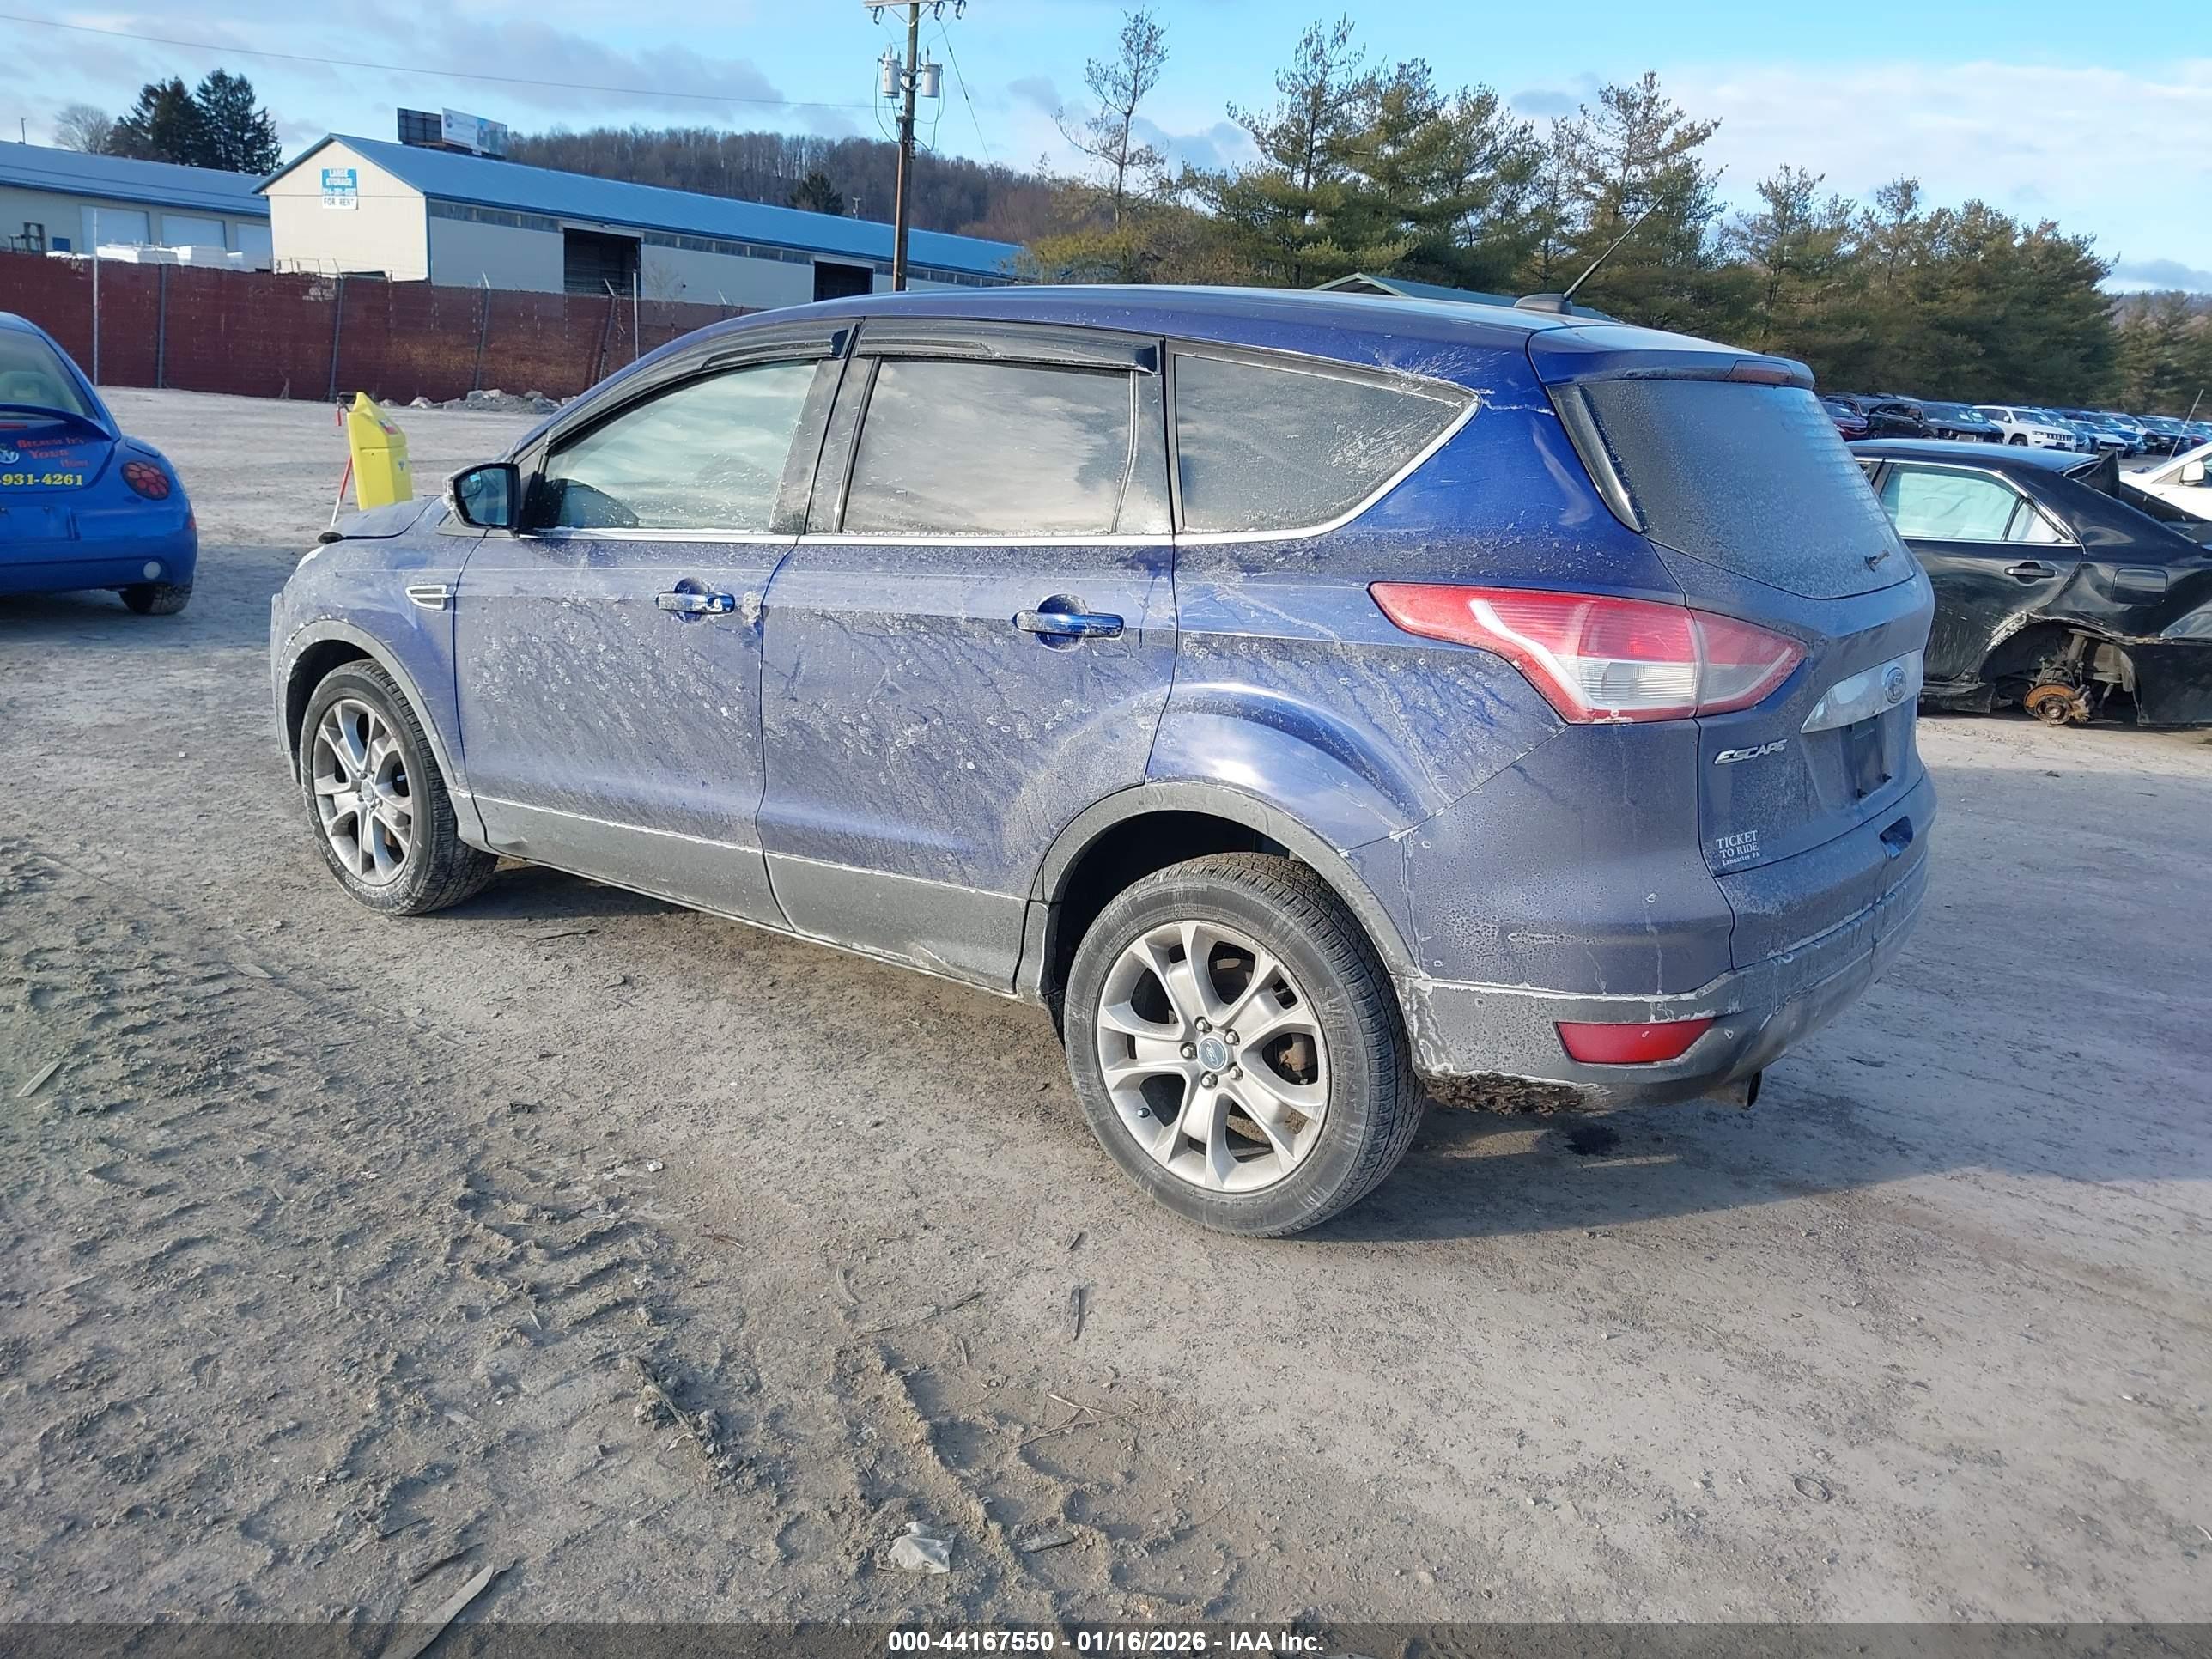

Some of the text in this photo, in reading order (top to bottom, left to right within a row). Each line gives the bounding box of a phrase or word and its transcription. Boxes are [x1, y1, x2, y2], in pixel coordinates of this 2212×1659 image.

[324, 198, 355, 207] FOR RENT
[1714, 738, 1788, 764] ESCAPE
[1716, 830, 1758, 849] TICKET
[1719, 842, 1759, 859] TO RIDE
